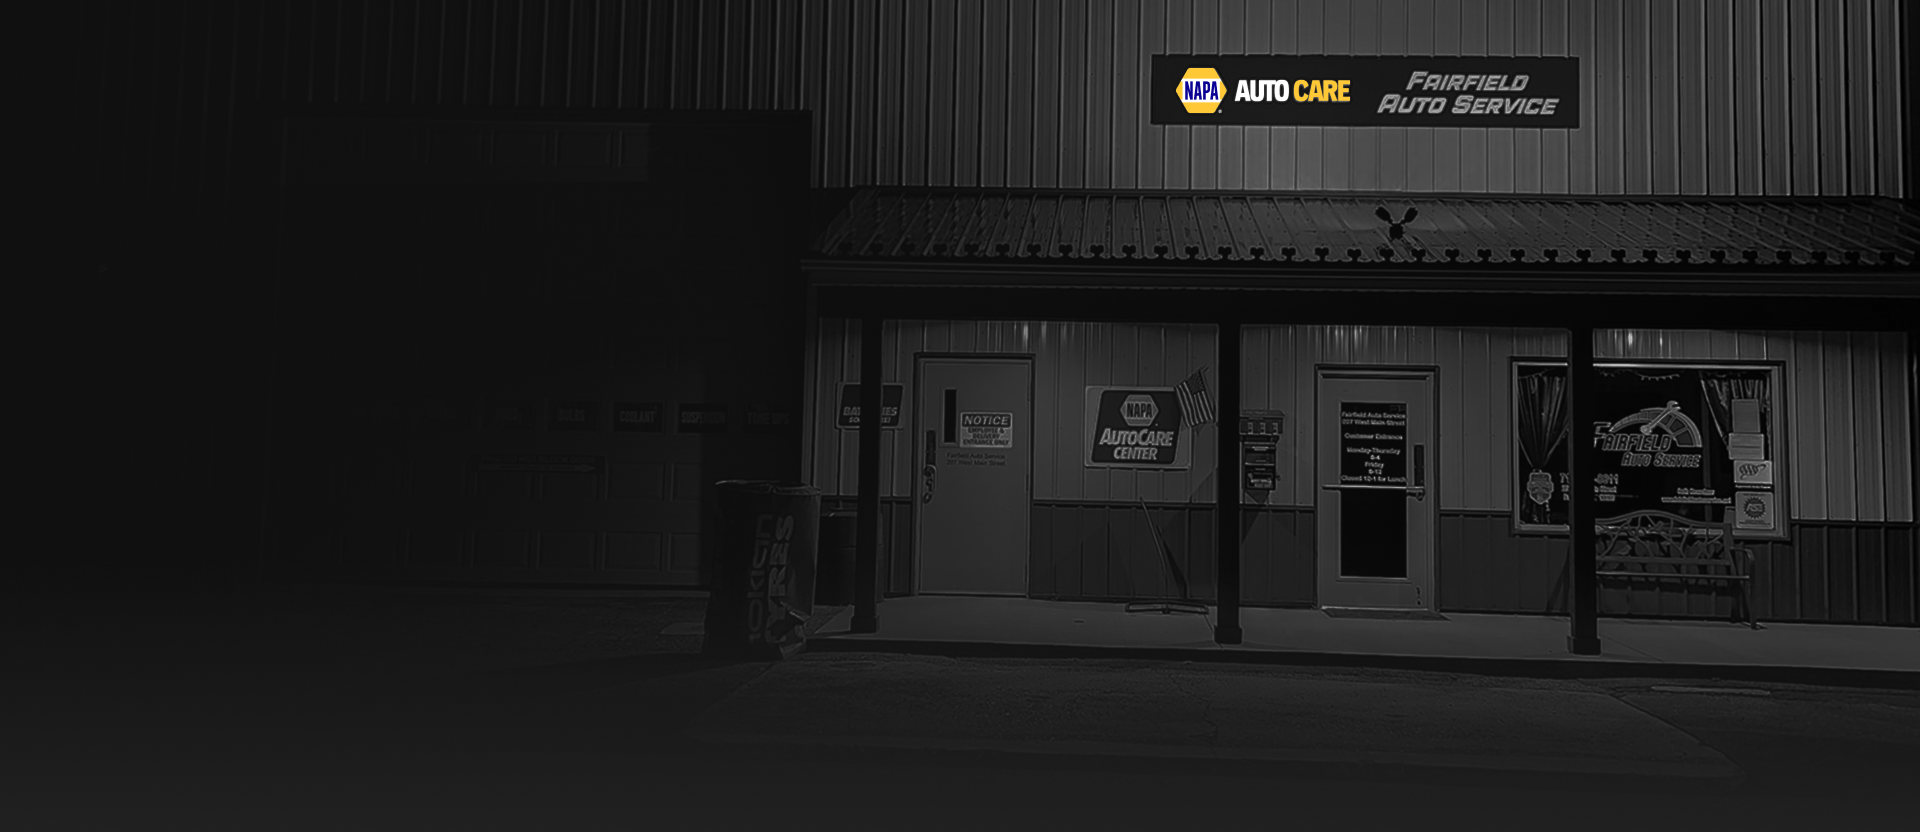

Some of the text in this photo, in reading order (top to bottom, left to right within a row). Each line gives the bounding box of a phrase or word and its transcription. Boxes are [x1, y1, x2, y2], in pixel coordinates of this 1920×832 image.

[1405, 71, 1530, 91] FAIRFIELD
[1183, 79, 1219, 101] NAPA
[1234, 78, 1351, 102] AUTO CARE
[1376, 93, 1560, 116] AUTO SERVICE
[619, 410, 655, 423] COOLANT
[681, 411, 726, 424] SUSPENSION
[746, 412, 790, 425] TUNE UPS
[1126, 403, 1153, 419] NAPA
[963, 415, 1010, 426] NOTICE
[1099, 427, 1175, 447] AUTOCARE
[1113, 446, 1159, 460] CENTER
[1620, 452, 1702, 468] AUTO SERVICE
[1364, 460, 1385, 469] Friday
